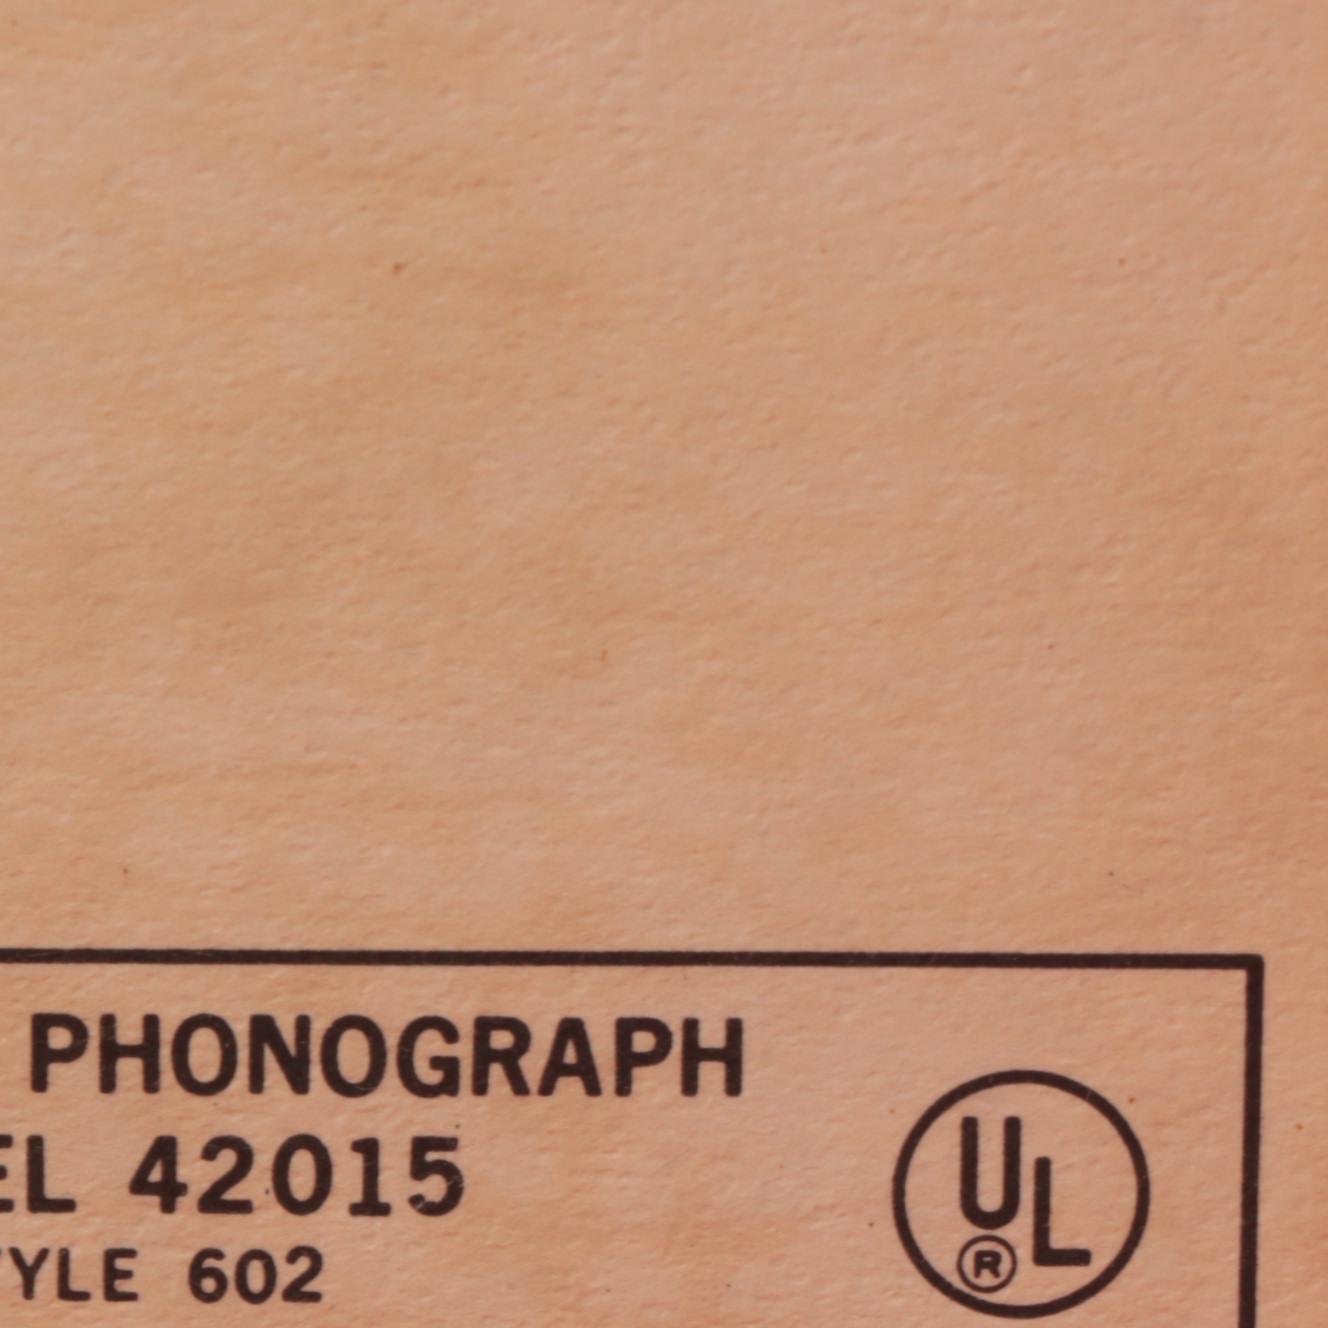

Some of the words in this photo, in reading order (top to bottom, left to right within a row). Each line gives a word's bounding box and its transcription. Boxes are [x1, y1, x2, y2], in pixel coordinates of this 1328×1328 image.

[30, 1012, 744, 1099] PHONOGRAPH
[128, 1133, 466, 1218] 42015
[959, 1115, 1093, 1268] UL
[187, 1247, 324, 1305] 602
